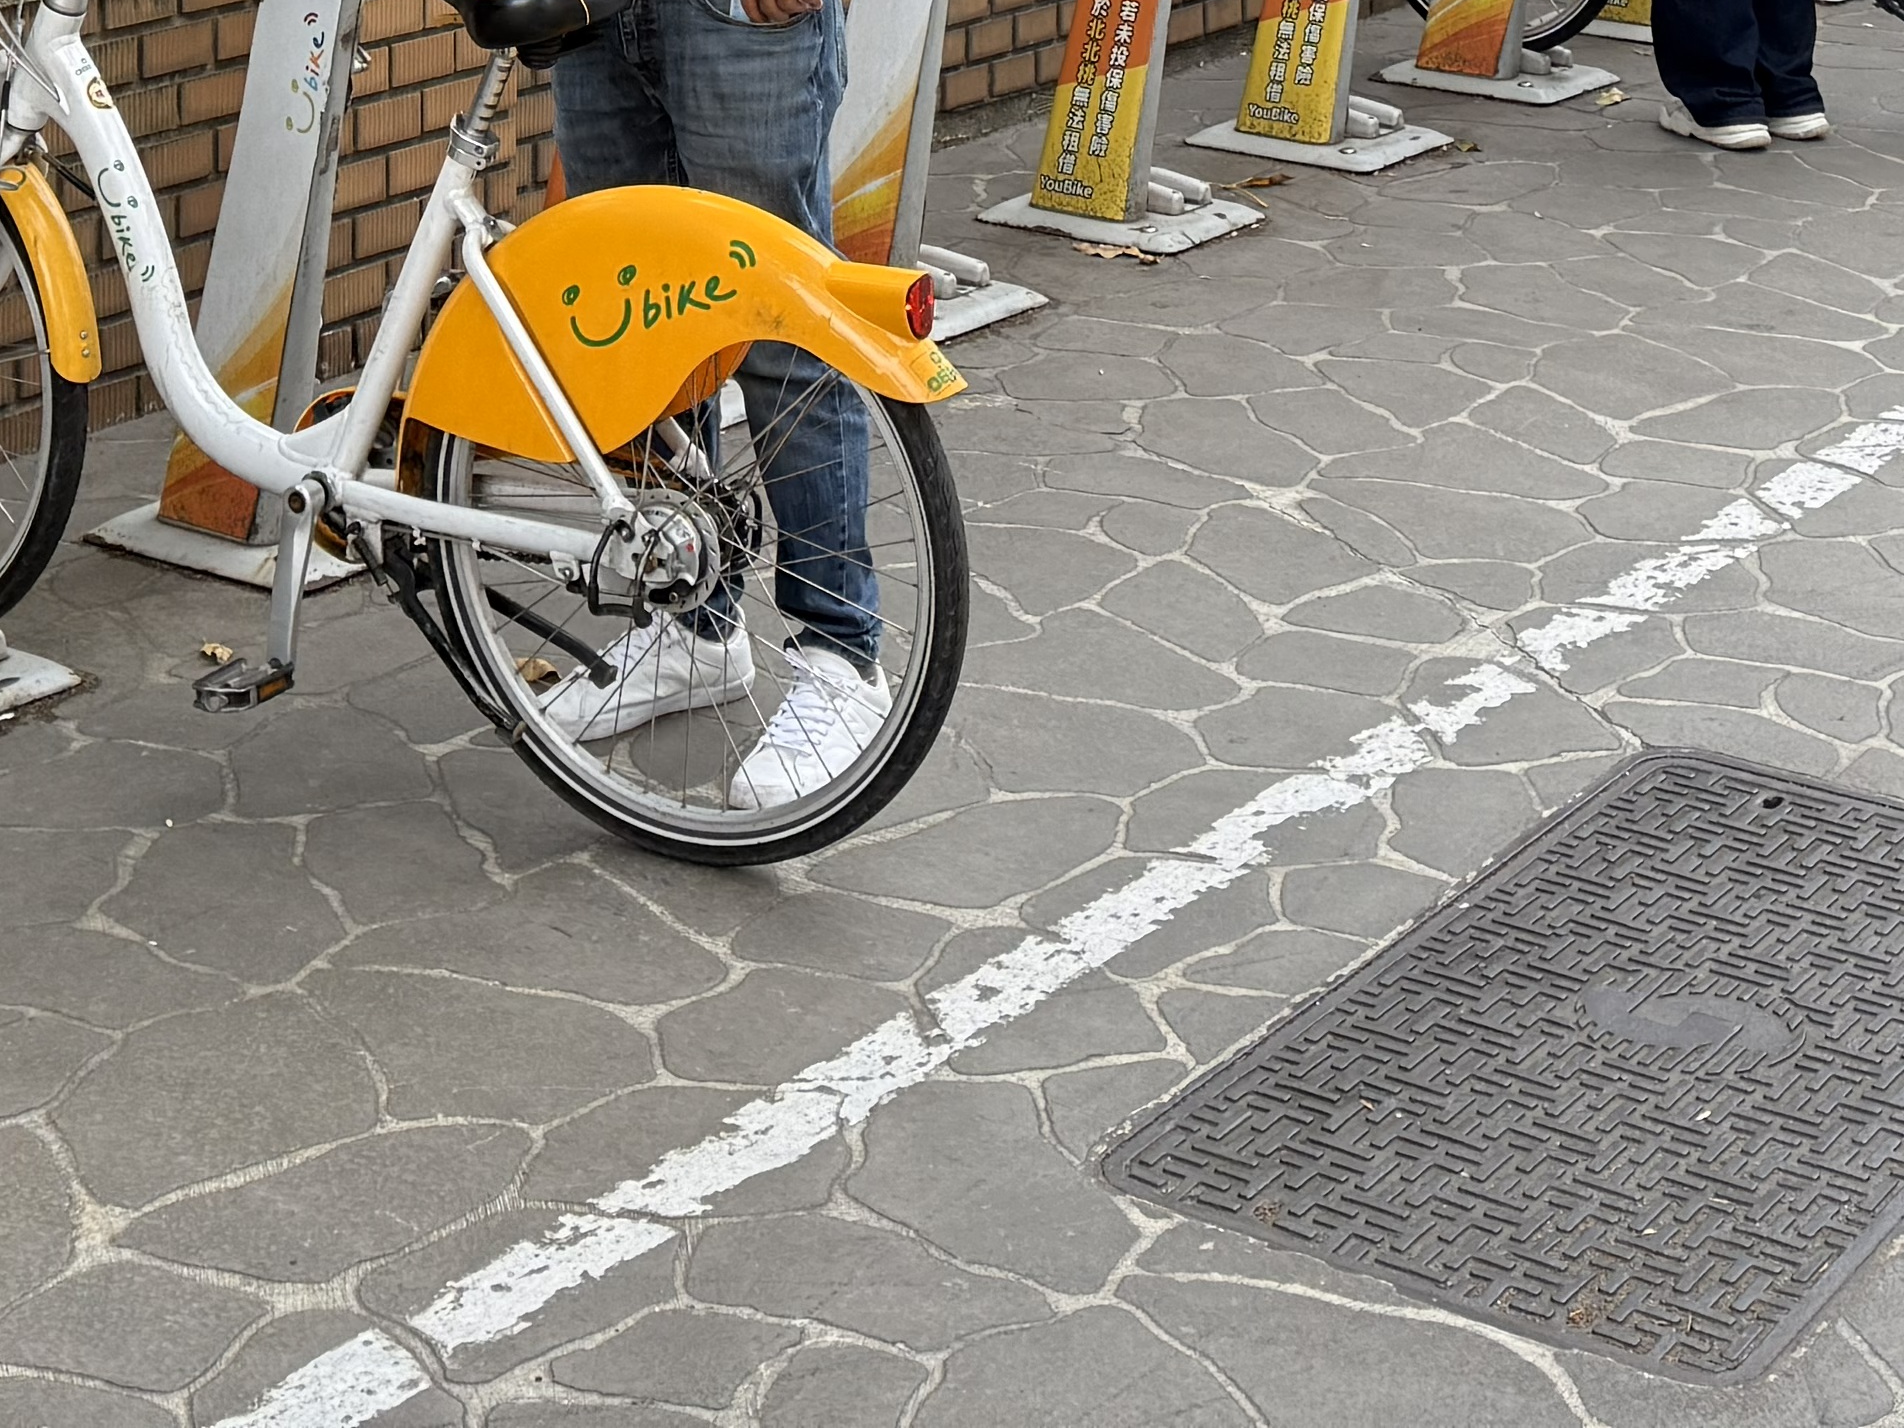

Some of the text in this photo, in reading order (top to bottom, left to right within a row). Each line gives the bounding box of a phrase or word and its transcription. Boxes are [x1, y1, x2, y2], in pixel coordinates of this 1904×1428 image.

[1088, 0, 1140, 157] 若未投保傷害險
[1248, 102, 1300, 125] YouBike
[1040, 174, 1094, 199] YouBike
